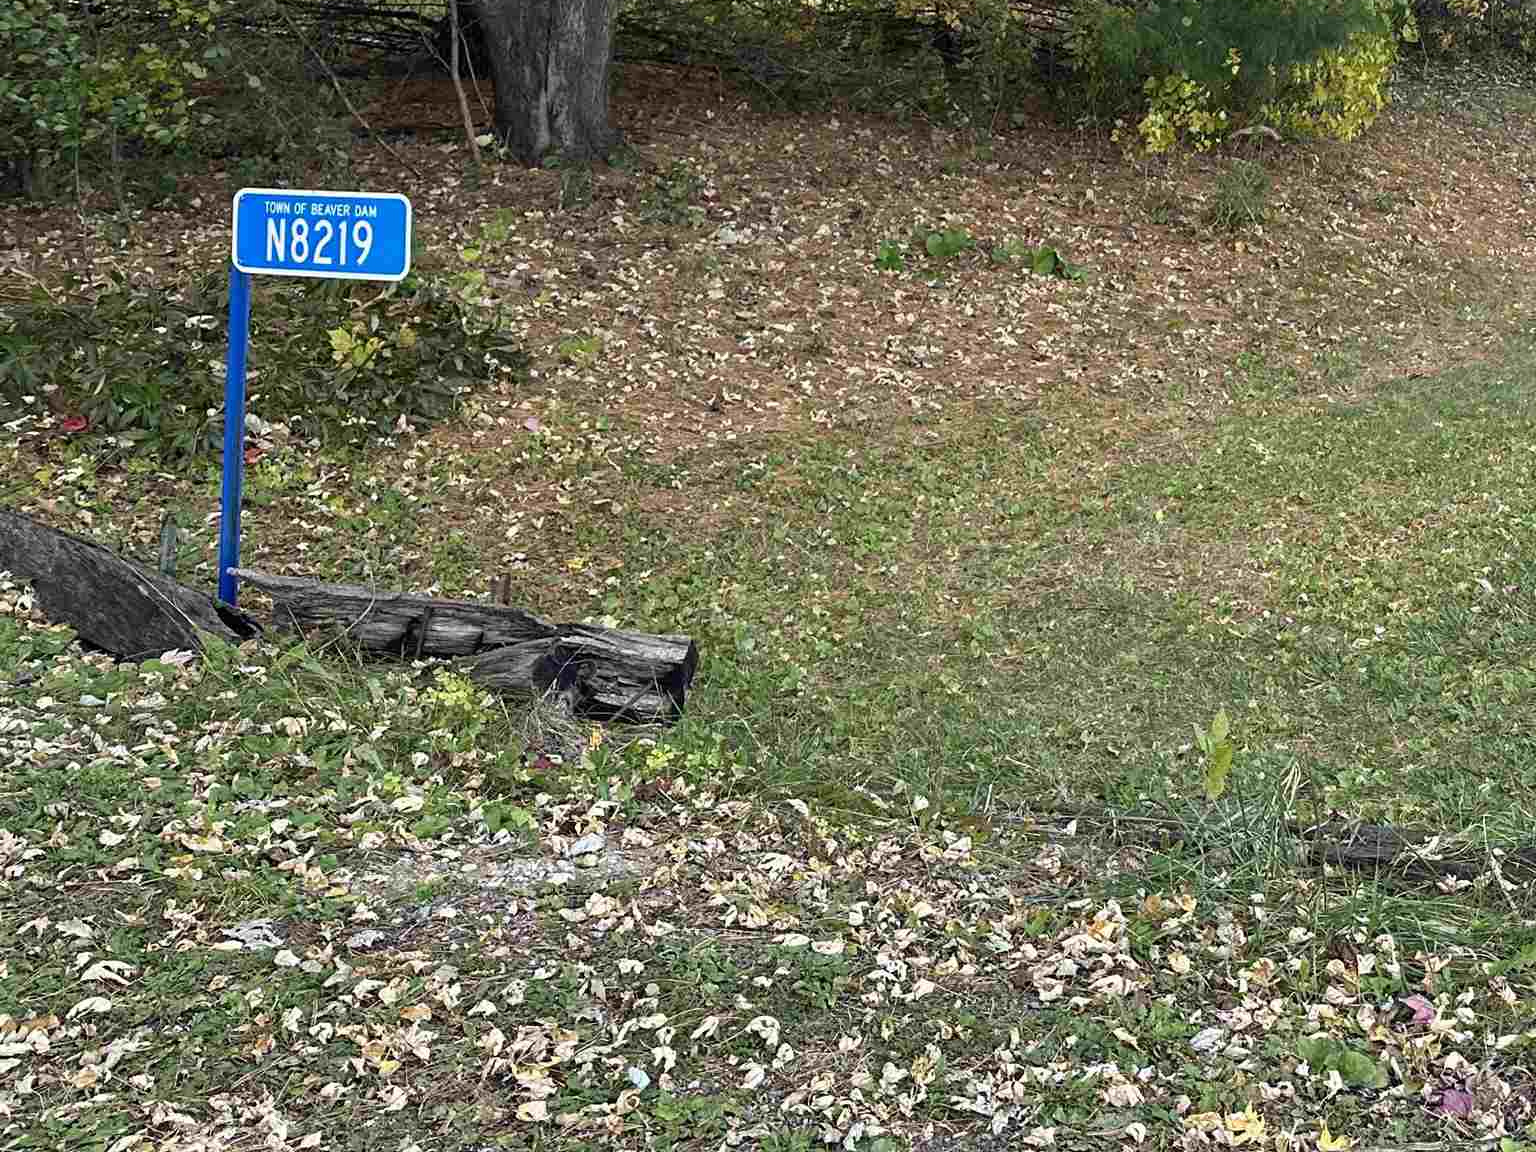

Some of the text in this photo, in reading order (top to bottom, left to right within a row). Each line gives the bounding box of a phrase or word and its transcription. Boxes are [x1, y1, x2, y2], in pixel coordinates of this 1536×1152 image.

[264, 201, 377, 217] TOWN OF BEAVER DAM
[266, 218, 373, 265] N8219
